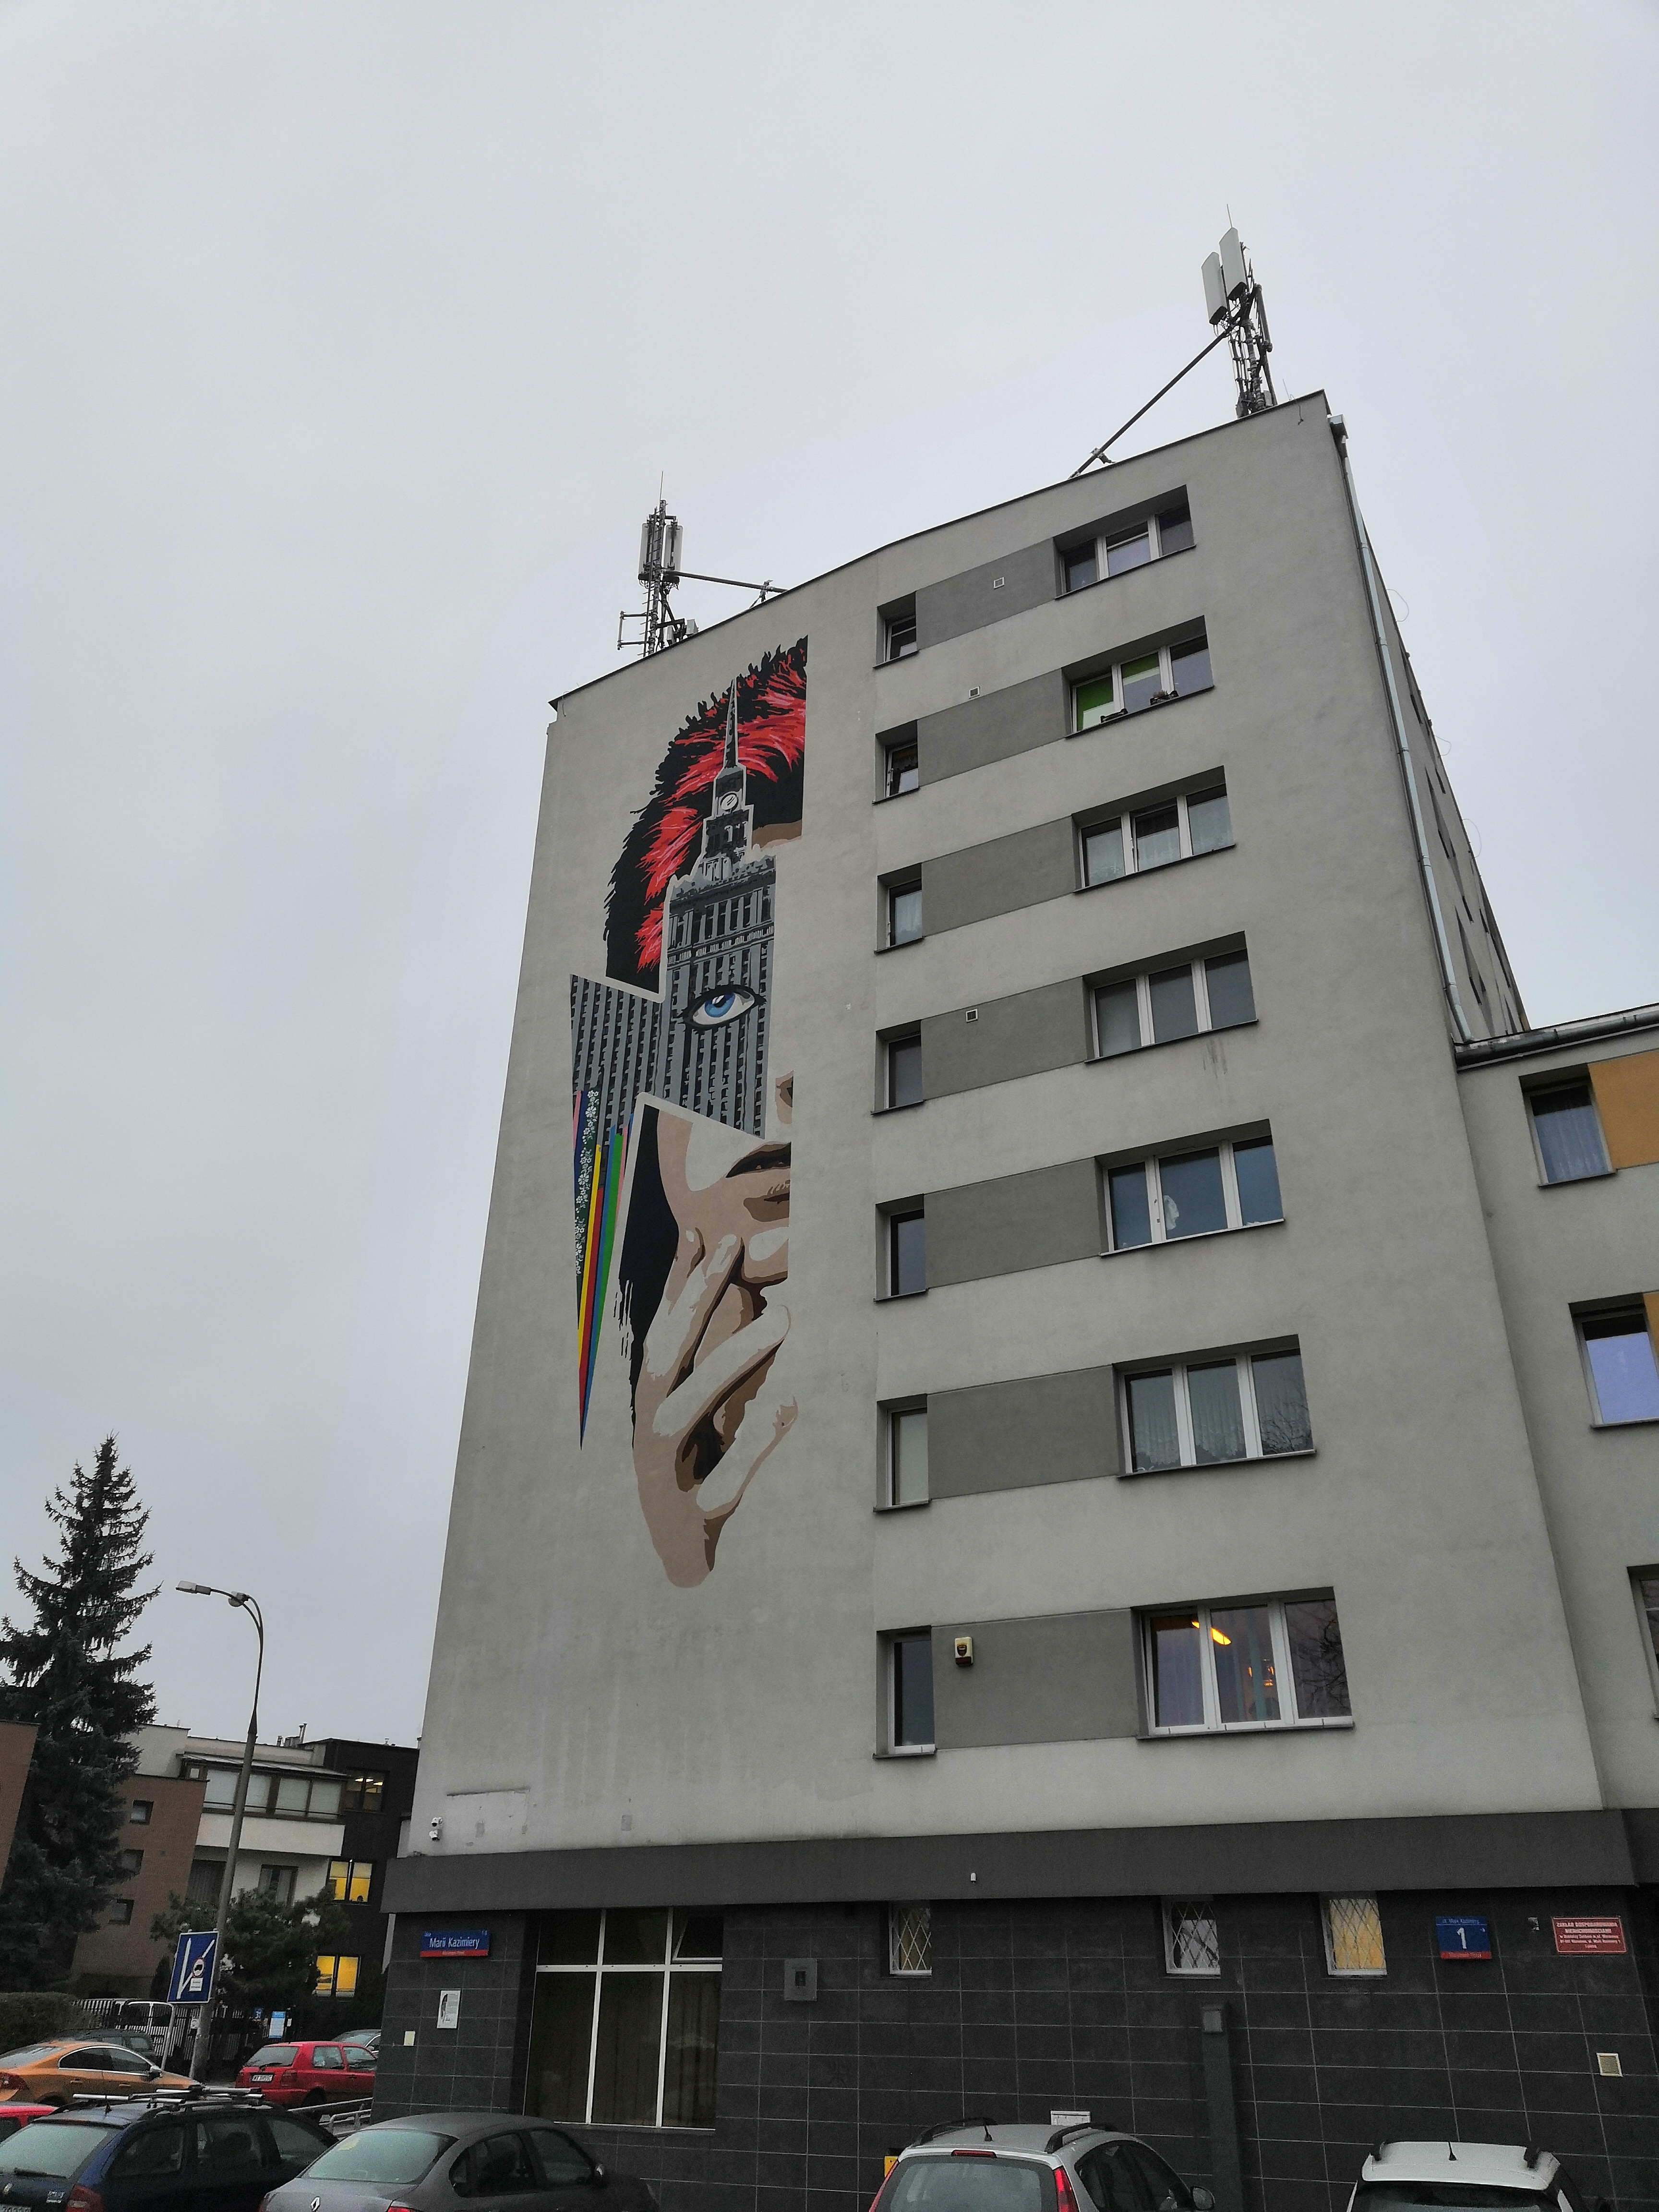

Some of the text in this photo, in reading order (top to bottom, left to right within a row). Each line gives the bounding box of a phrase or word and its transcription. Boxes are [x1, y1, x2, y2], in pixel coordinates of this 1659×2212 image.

[429, 1936, 480, 1950] Marii Kazimiery
[1457, 1927, 1467, 1949] 1
